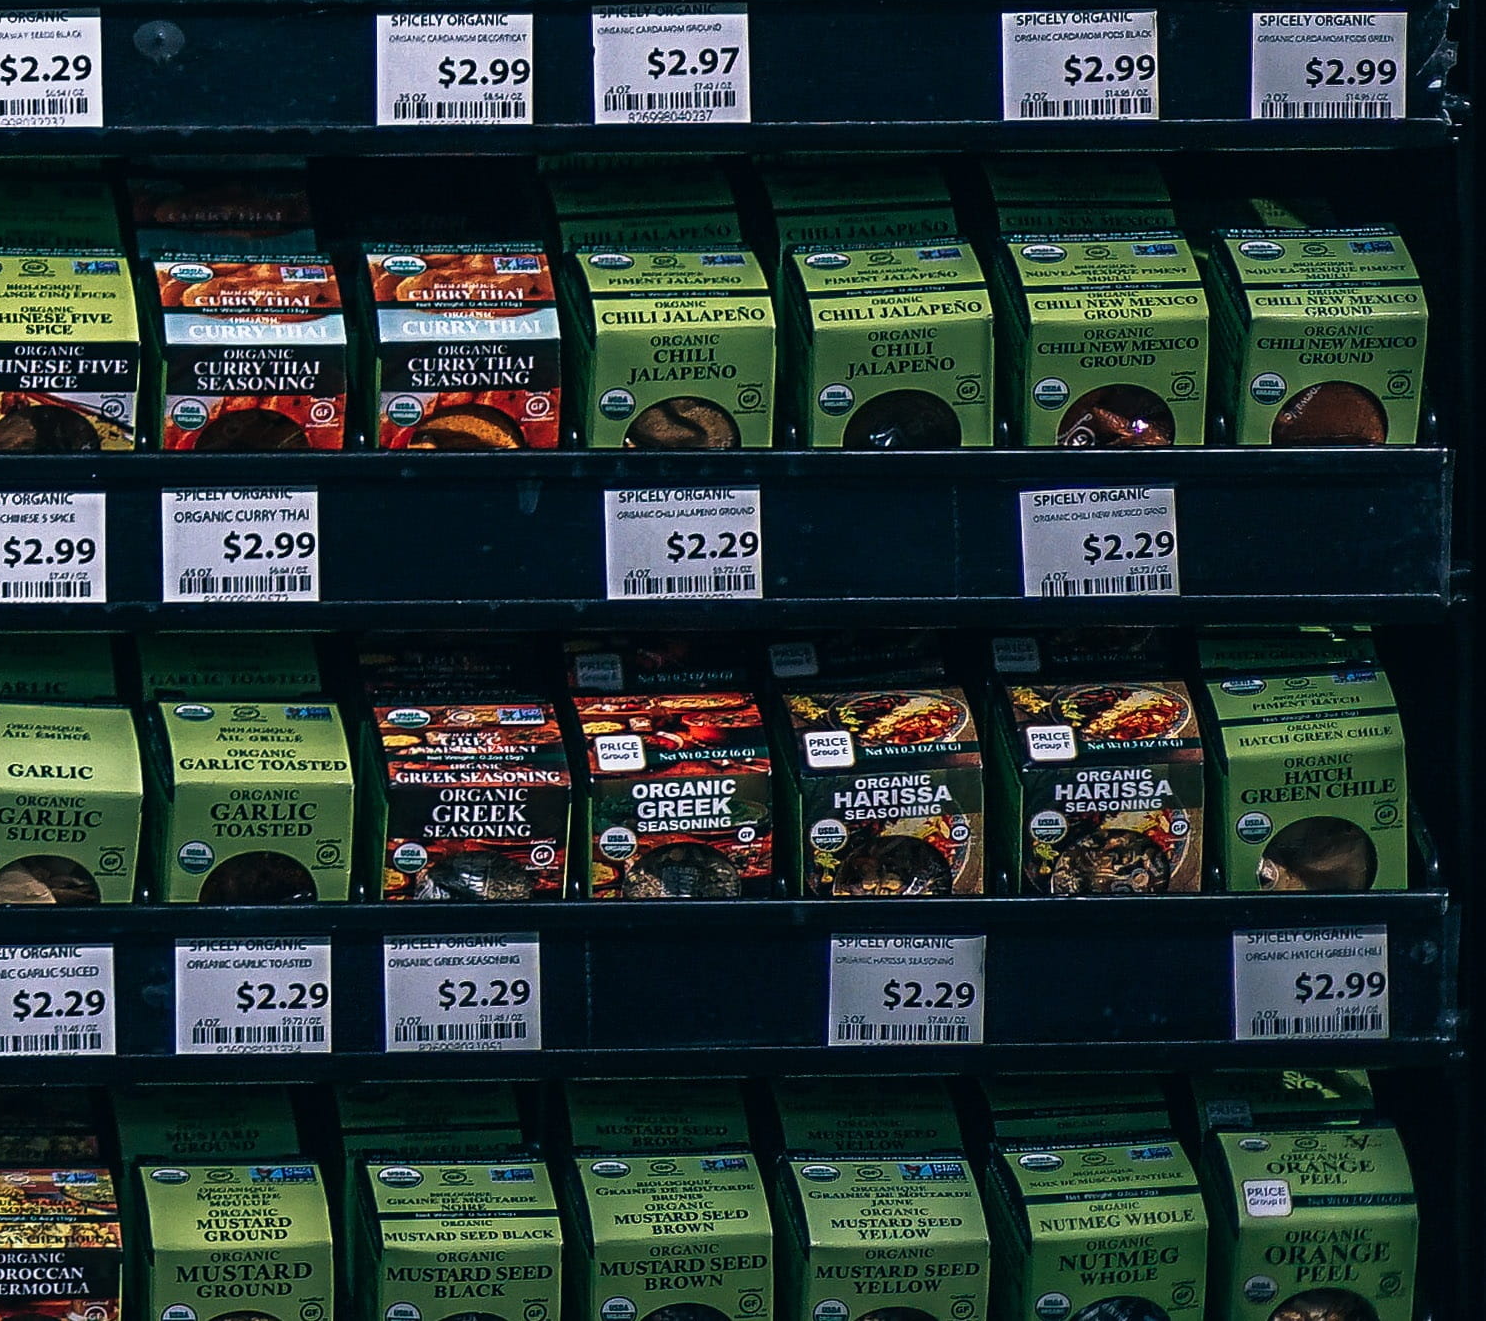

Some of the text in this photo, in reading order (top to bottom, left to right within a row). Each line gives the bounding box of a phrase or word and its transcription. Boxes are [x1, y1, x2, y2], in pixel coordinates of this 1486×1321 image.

[648, 47, 739, 79] $2.97
[1306, 57, 1396, 88] $2.99
[78, 360, 128, 373] FIVE
[224, 531, 315, 563] $2.99
[1084, 531, 1174, 565] $2.29
[835, 785, 952, 813] HARISSA
[1240, 778, 1398, 805] GREEN CHILE
[433, 805, 526, 822] GREEK
[1295, 972, 1385, 1004] $2.99
[13, 990, 105, 1022] $2.29
[1058, 1246, 1179, 1271] NUTMEG
[1265, 1241, 1390, 1265] ORANGE
